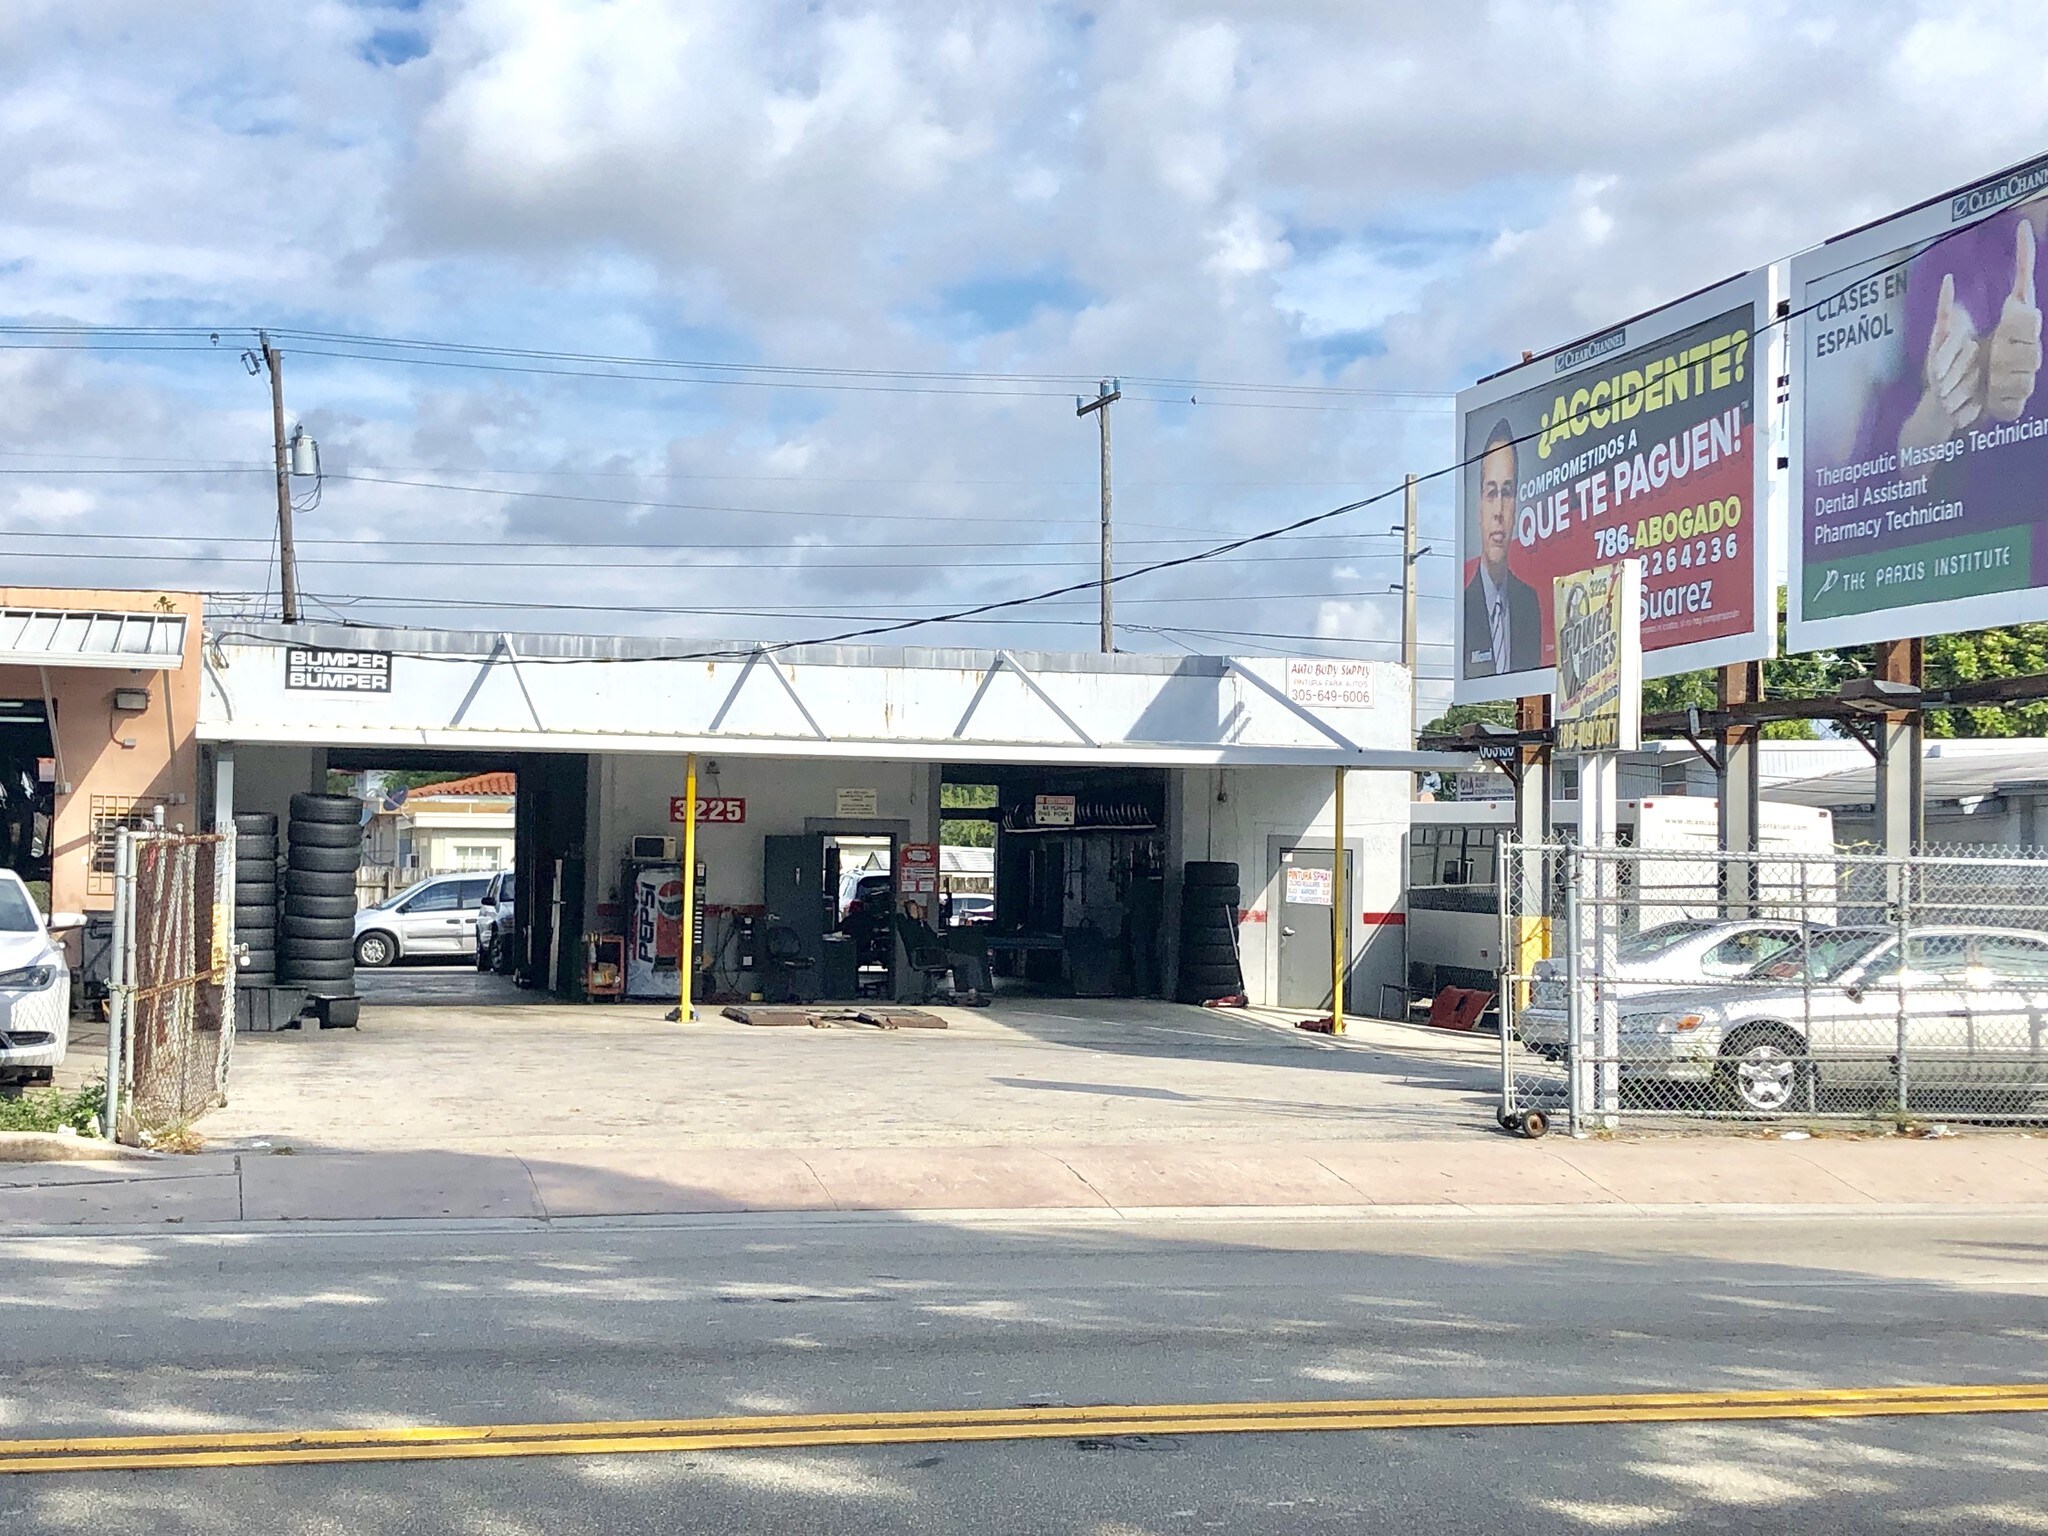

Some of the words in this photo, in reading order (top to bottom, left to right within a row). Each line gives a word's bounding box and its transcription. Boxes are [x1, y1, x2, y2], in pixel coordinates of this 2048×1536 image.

[1816, 281, 1879, 322] CLASES
[1884, 269, 1908, 299] EN
[1816, 312, 1894, 358] ESPAÑOL
[1538, 329, 1749, 459] ¿ACCIDENTE?
[1518, 488, 1570, 548] QUE
[1575, 471, 1608, 521] TE
[1614, 406, 1742, 506] PAGUEN!
[1519, 435, 1624, 502] COMPROMETIDOS
[1627, 428, 1638, 450] A
[1815, 451, 1897, 487] Therapeutic
[1900, 437, 1964, 468] Massage
[1815, 488, 1859, 517] Dental
[1863, 475, 1928, 506] Assistant
[1594, 495, 1742, 559] 786-ABOGADO
[1815, 517, 1882, 545] Pharmacy
[1886, 499, 1963, 531] Technician
[1843, 571, 1865, 591] THE
[1934, 546, 2011, 577] INSTITUTE
[1640, 580, 1713, 622] Suarez
[1563, 603, 1613, 663] POWER
[289, 672, 388, 689] BUMPER
[290, 650, 388, 668] BUMPER
[306, 665, 324, 673] TO
[1291, 663, 1314, 675] AUTO
[1315, 664, 1338, 677] BODY
[1341, 664, 1371, 679] SUPPLY
[1579, 631, 1618, 684] TIRES
[1291, 688, 1370, 703] 305-649-6006
[674, 800, 742, 821] 3225
[638, 881, 657, 965] PEPSI
